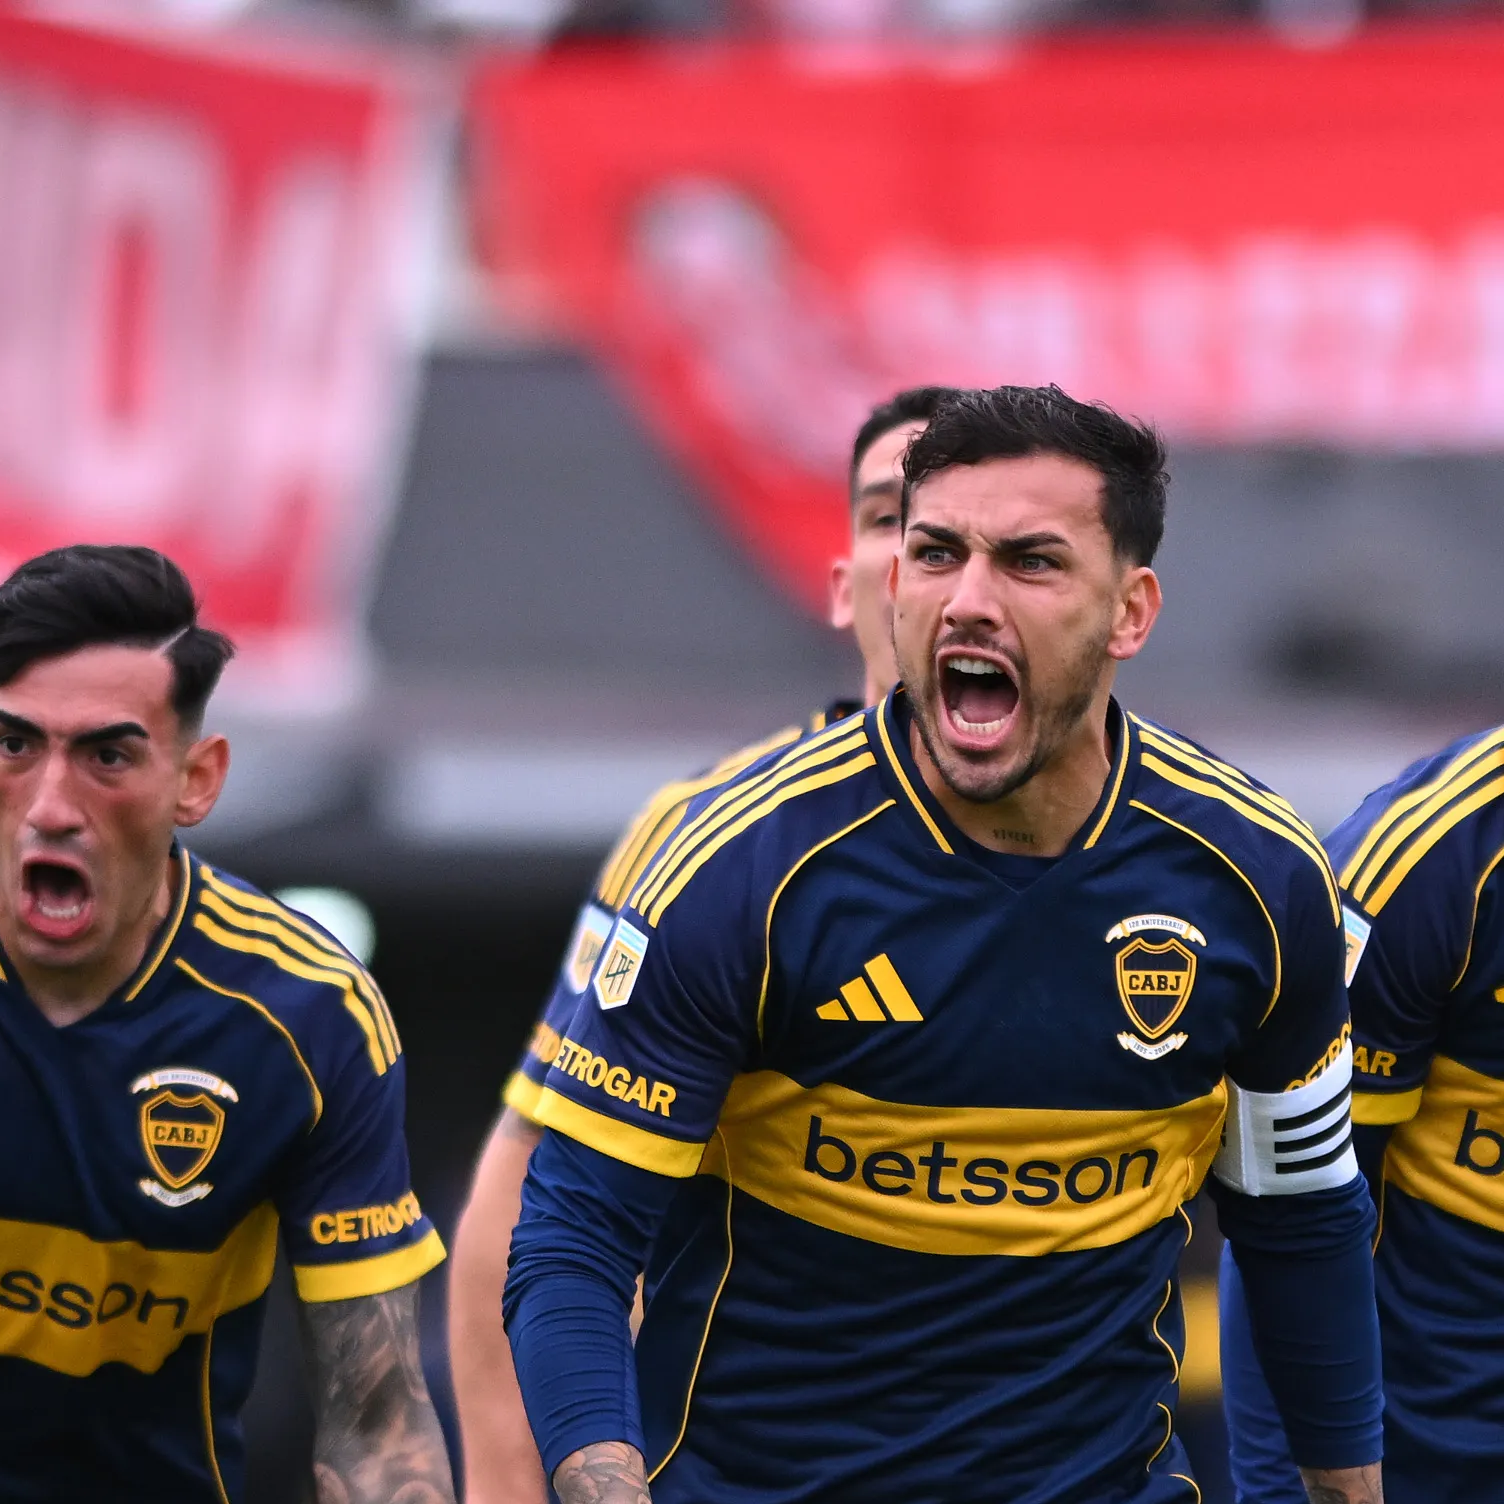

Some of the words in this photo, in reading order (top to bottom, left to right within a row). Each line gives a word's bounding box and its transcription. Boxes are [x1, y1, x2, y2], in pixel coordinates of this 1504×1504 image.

[1128, 974, 1182, 992] CABJ
[153, 1125, 209, 1144] CABJ
[803, 1115, 1160, 1207] betsson
